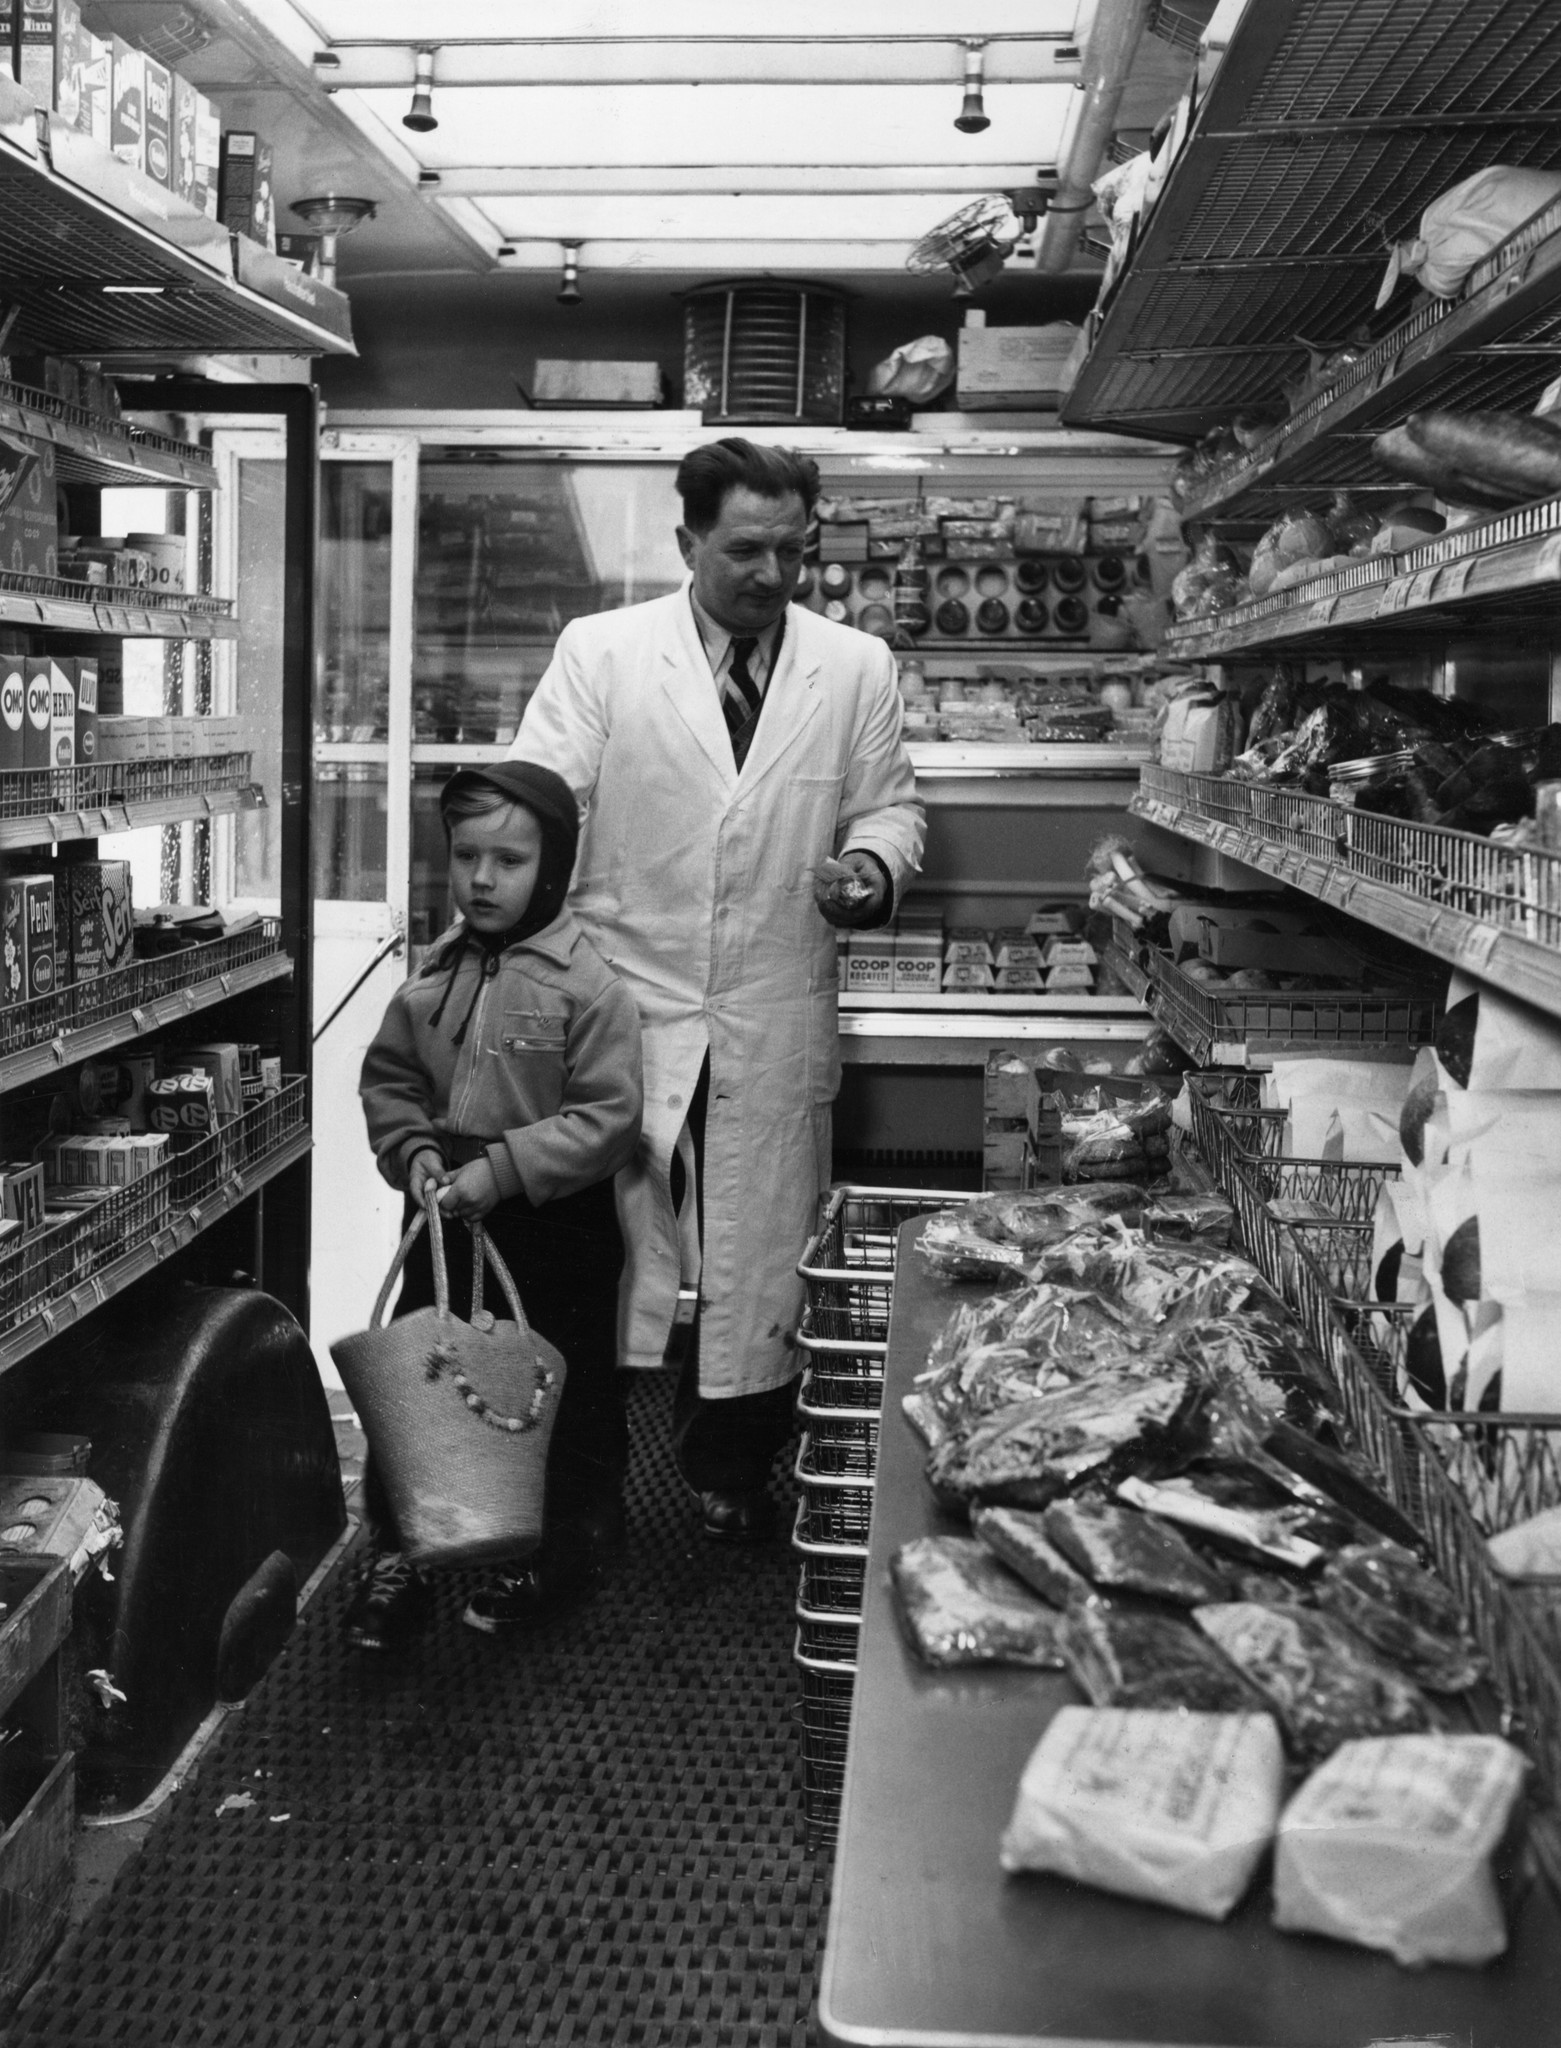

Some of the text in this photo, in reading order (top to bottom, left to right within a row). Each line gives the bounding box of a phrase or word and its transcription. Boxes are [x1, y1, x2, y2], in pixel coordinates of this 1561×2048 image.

[30, 891, 52, 934] Persil
[80, 919, 94, 937] gibt
[81, 936, 93, 948] die
[13, 1174, 42, 1232] VEL
